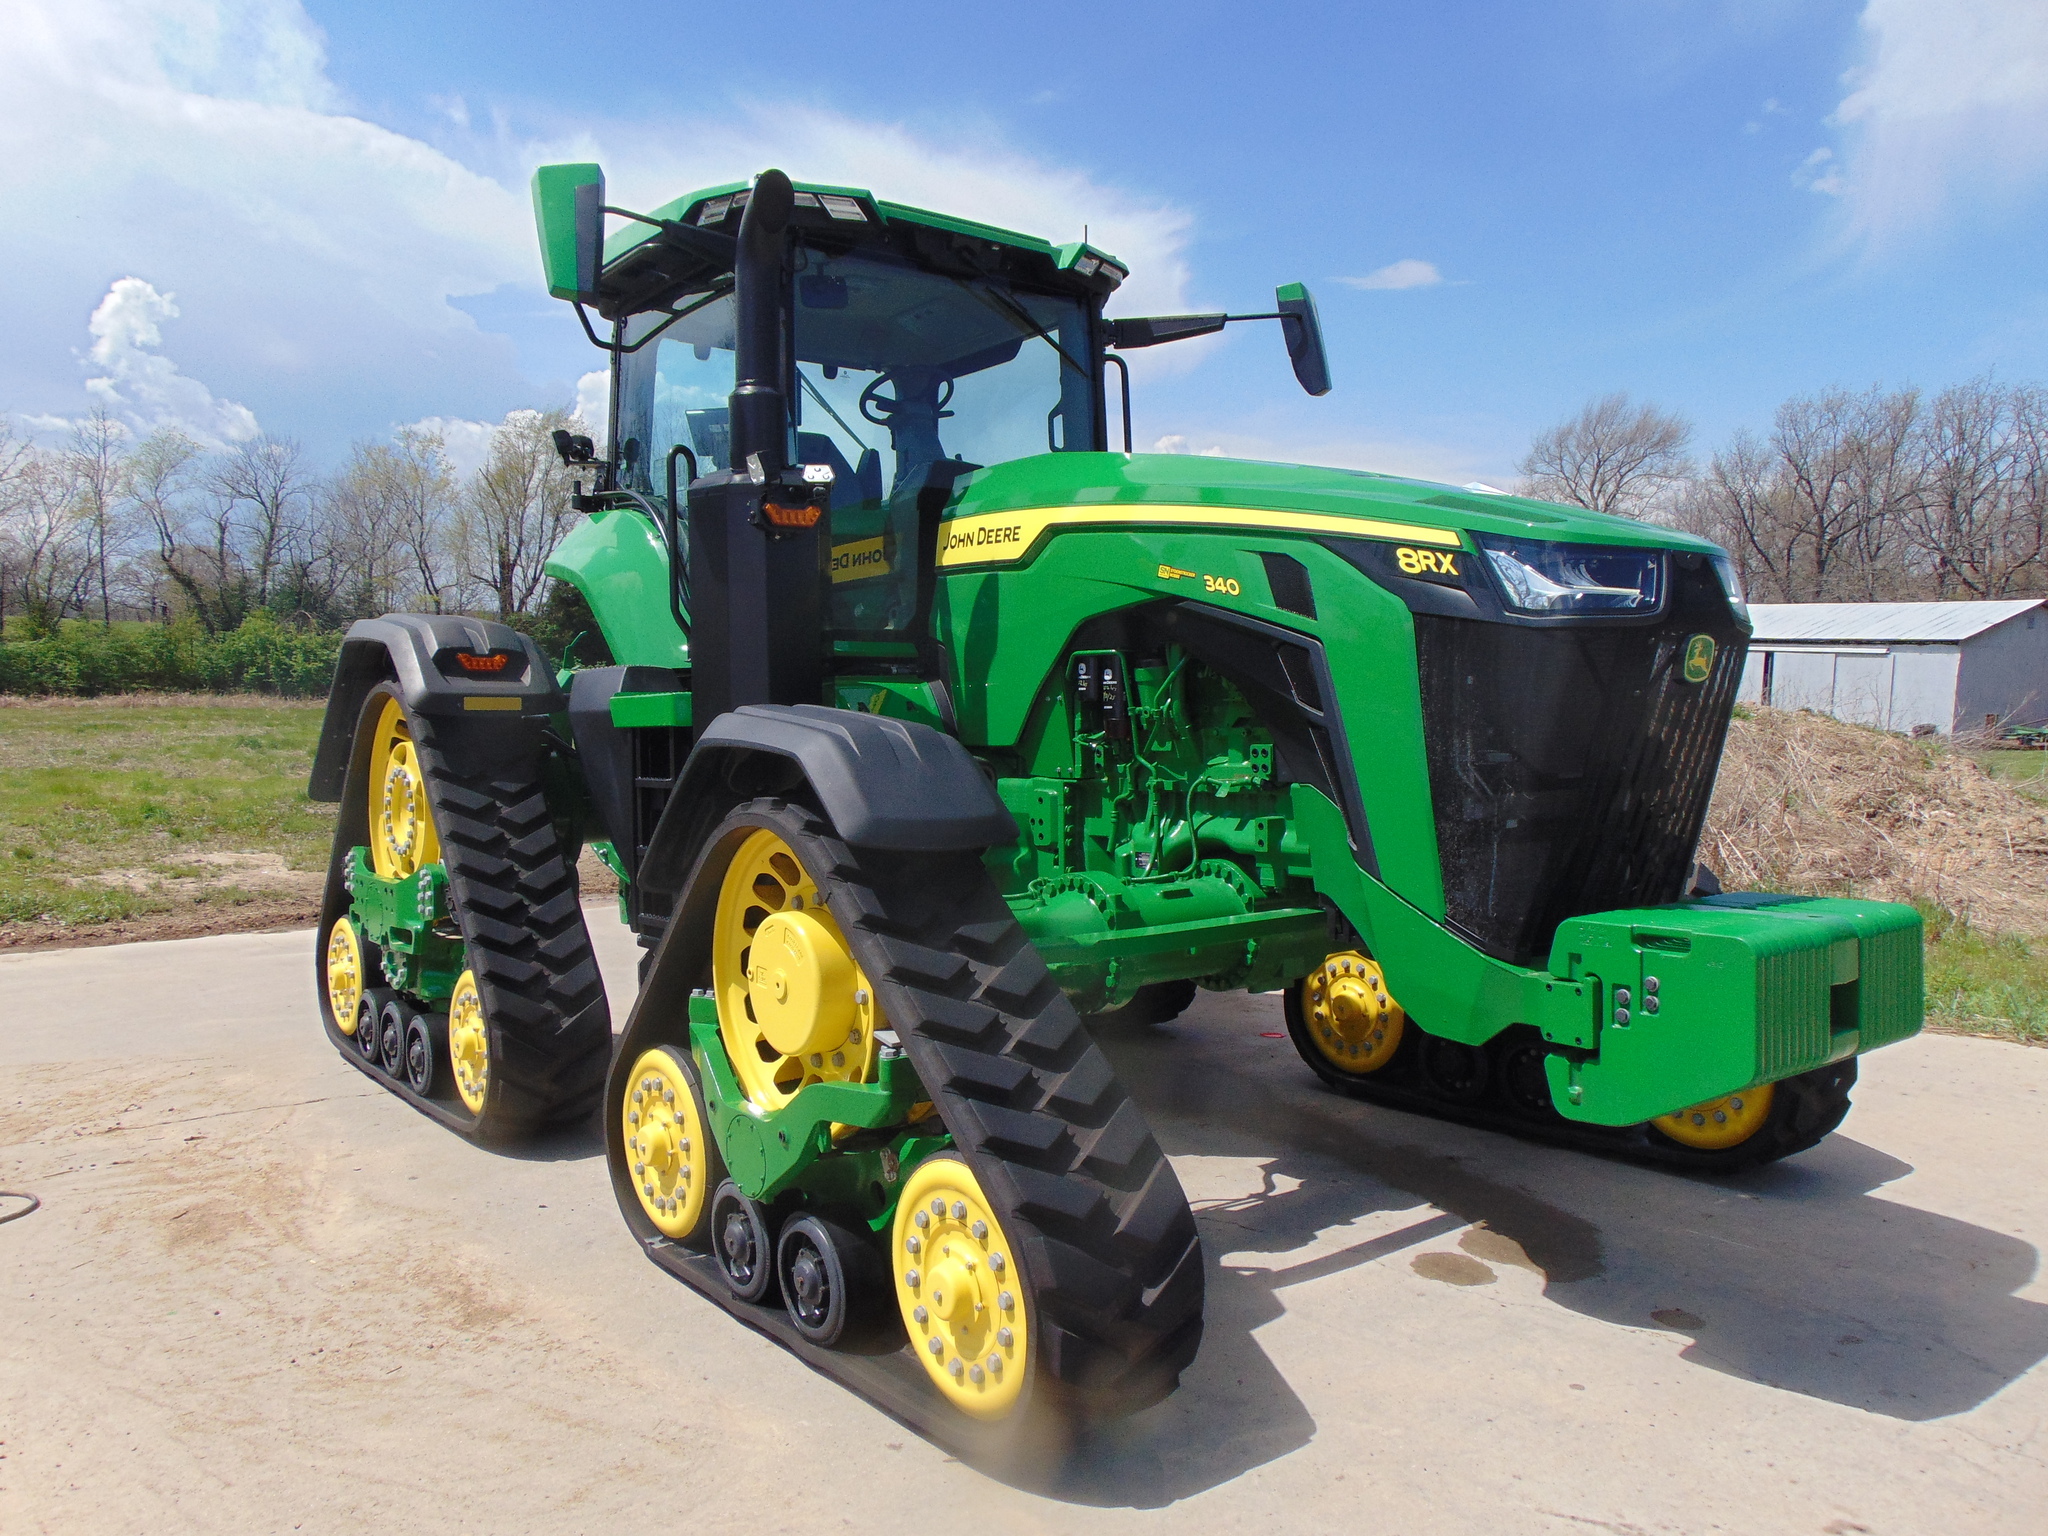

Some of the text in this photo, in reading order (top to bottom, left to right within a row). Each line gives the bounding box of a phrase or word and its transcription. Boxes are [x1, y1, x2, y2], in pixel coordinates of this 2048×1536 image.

[943, 526, 1021, 551] JOHN DEERE
[1396, 547, 1459, 576] 8RX
[1203, 574, 1240, 596] 340
